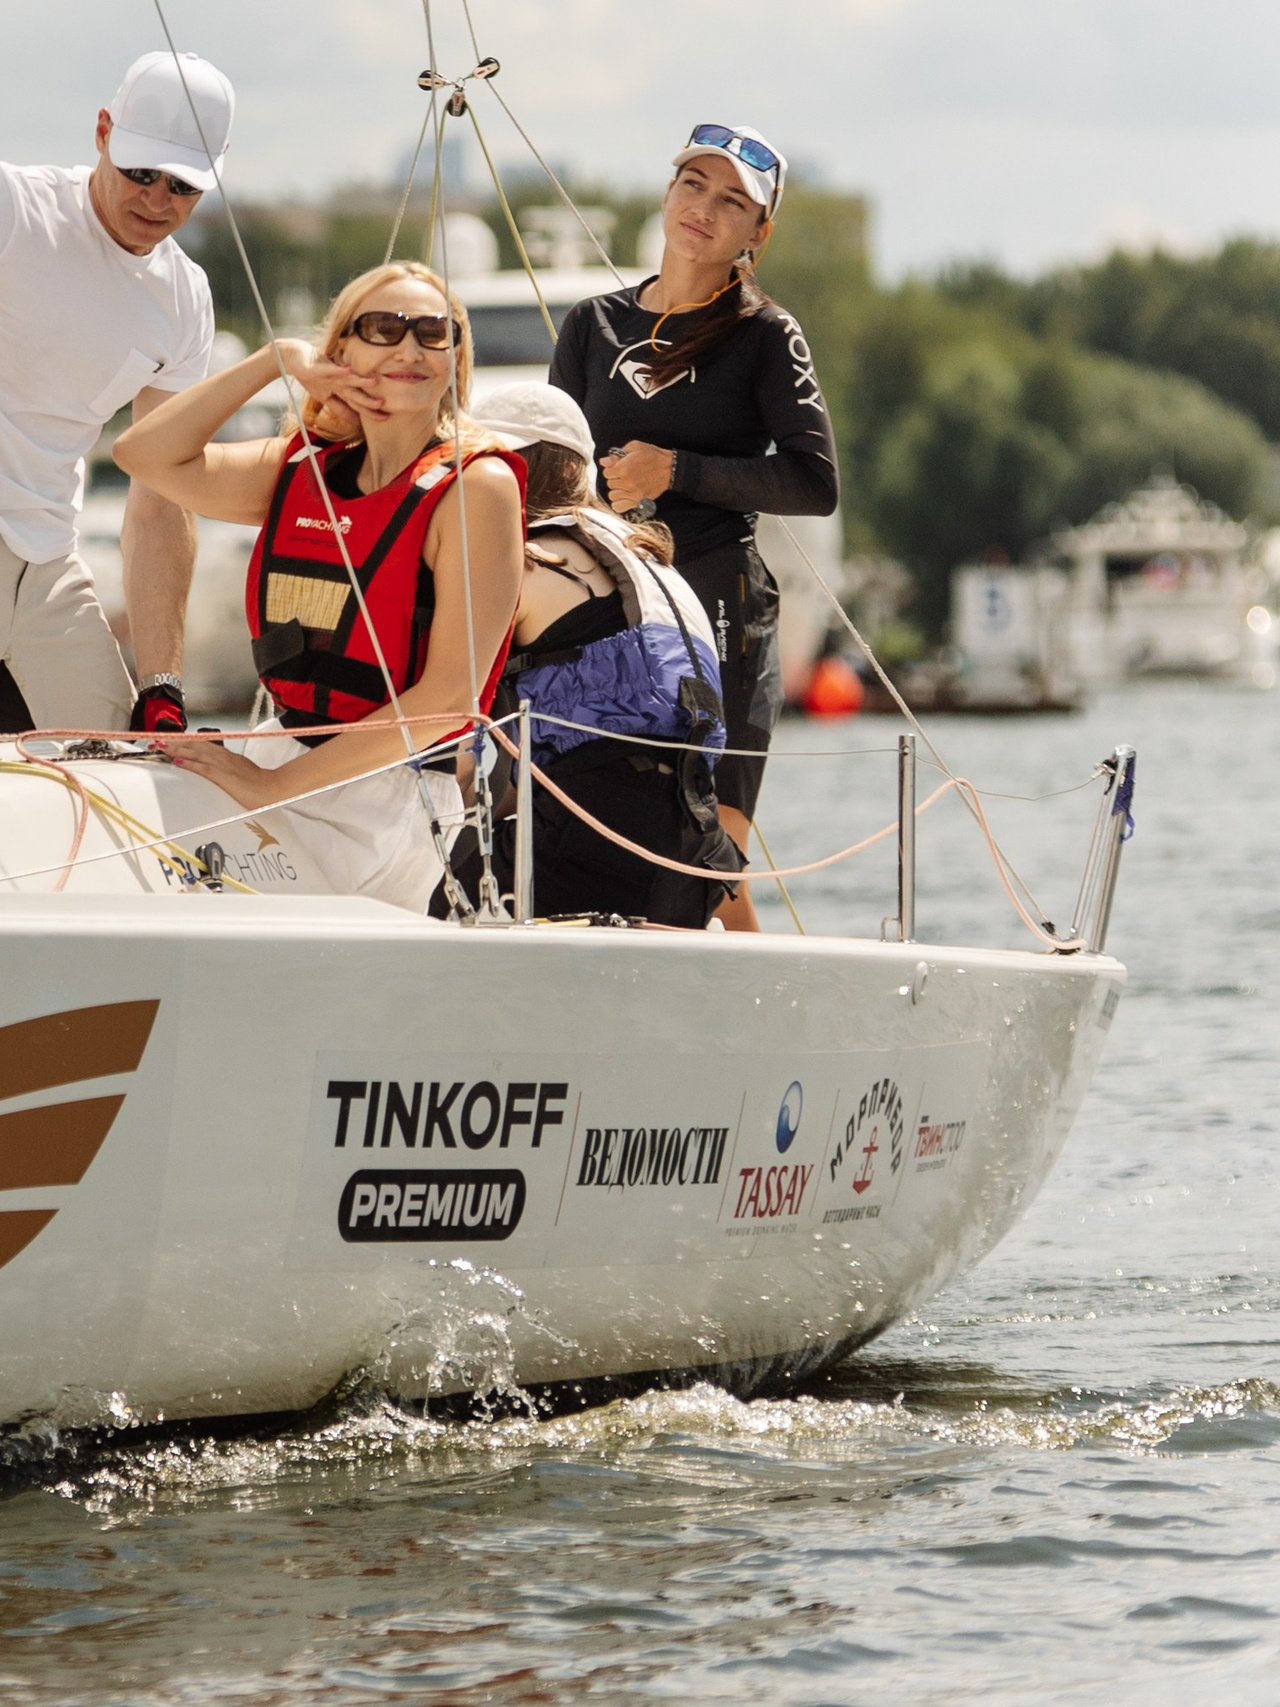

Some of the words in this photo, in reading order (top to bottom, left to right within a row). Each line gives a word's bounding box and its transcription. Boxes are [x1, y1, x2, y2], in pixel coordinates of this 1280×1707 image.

[777, 314, 825, 413] ROXY
[326, 1081, 569, 1150] TINKOFF
[576, 1126, 729, 1194] ВЕДОМОСТИ
[733, 1164, 814, 1219] TASSAY
[348, 1183, 517, 1228] PREMIUM
